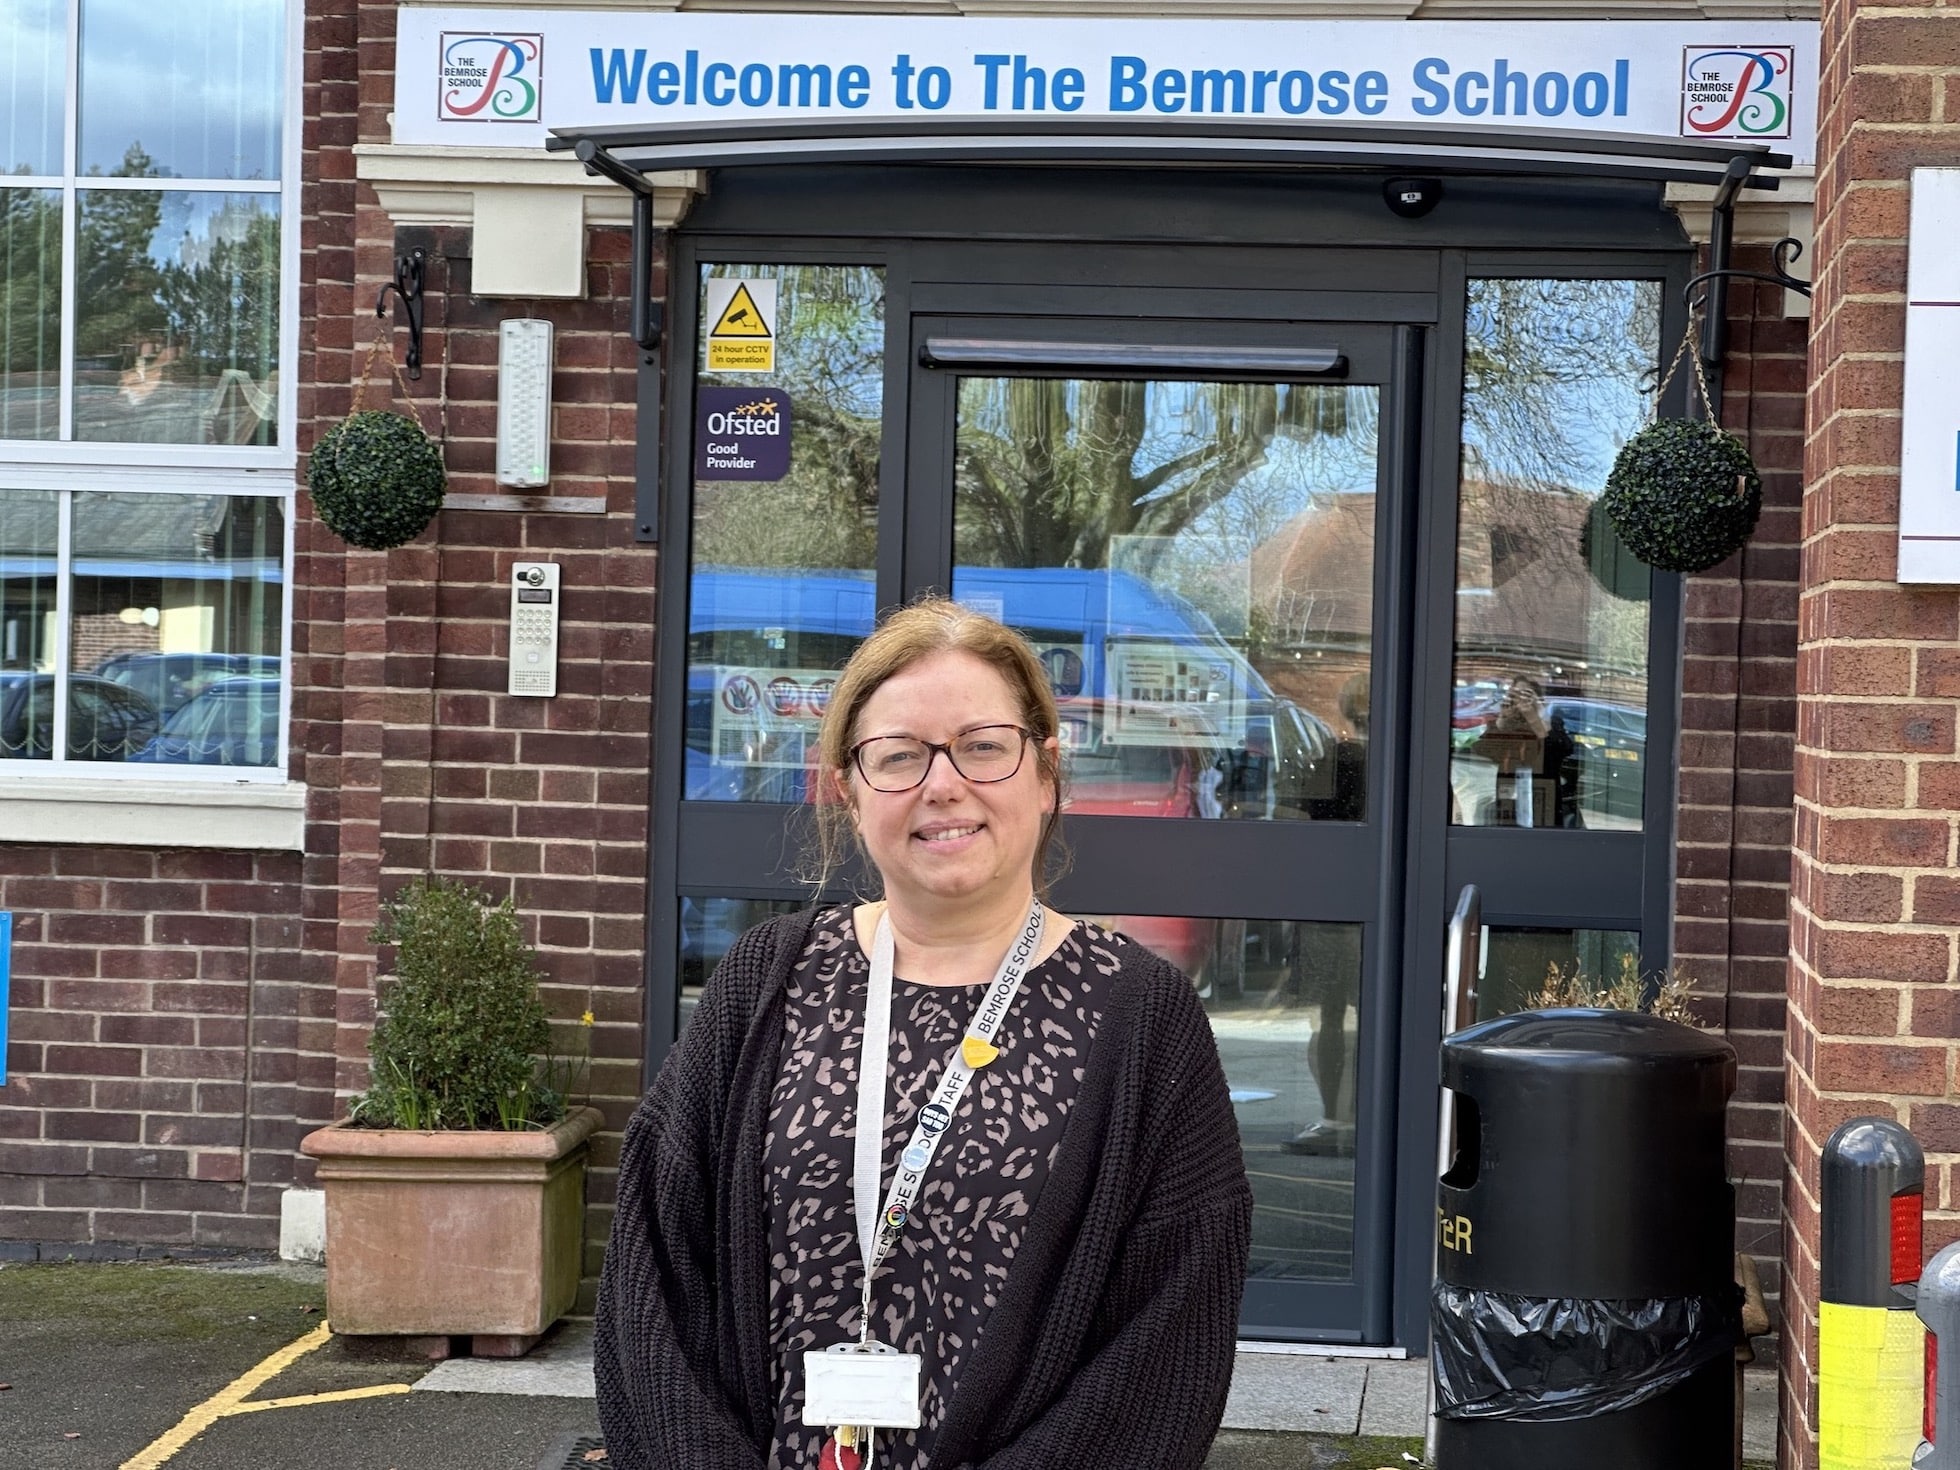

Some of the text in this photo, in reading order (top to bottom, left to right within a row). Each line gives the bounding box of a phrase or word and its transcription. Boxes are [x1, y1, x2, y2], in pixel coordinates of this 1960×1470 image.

[458, 57, 475, 67] THE
[444, 67, 487, 77] BEMROSE
[1701, 72, 1720, 81] THE
[447, 78, 483, 88] SCHOOL
[589, 48, 1629, 117] Welcome to The Bemrose School
[1687, 82, 1734, 92] BEMROSE
[1691, 93, 1729, 103] SCHOOL
[712, 345, 769, 353] 24 hour CCTV
[716, 355, 766, 364] in operation
[707, 411, 780, 436] Ofsted
[706, 442, 739, 455] Good
[706, 457, 756, 469] Provider
[978, 911, 1042, 1034] BEMROSE SCHOOL
[938, 1071, 964, 1105] TAFF
